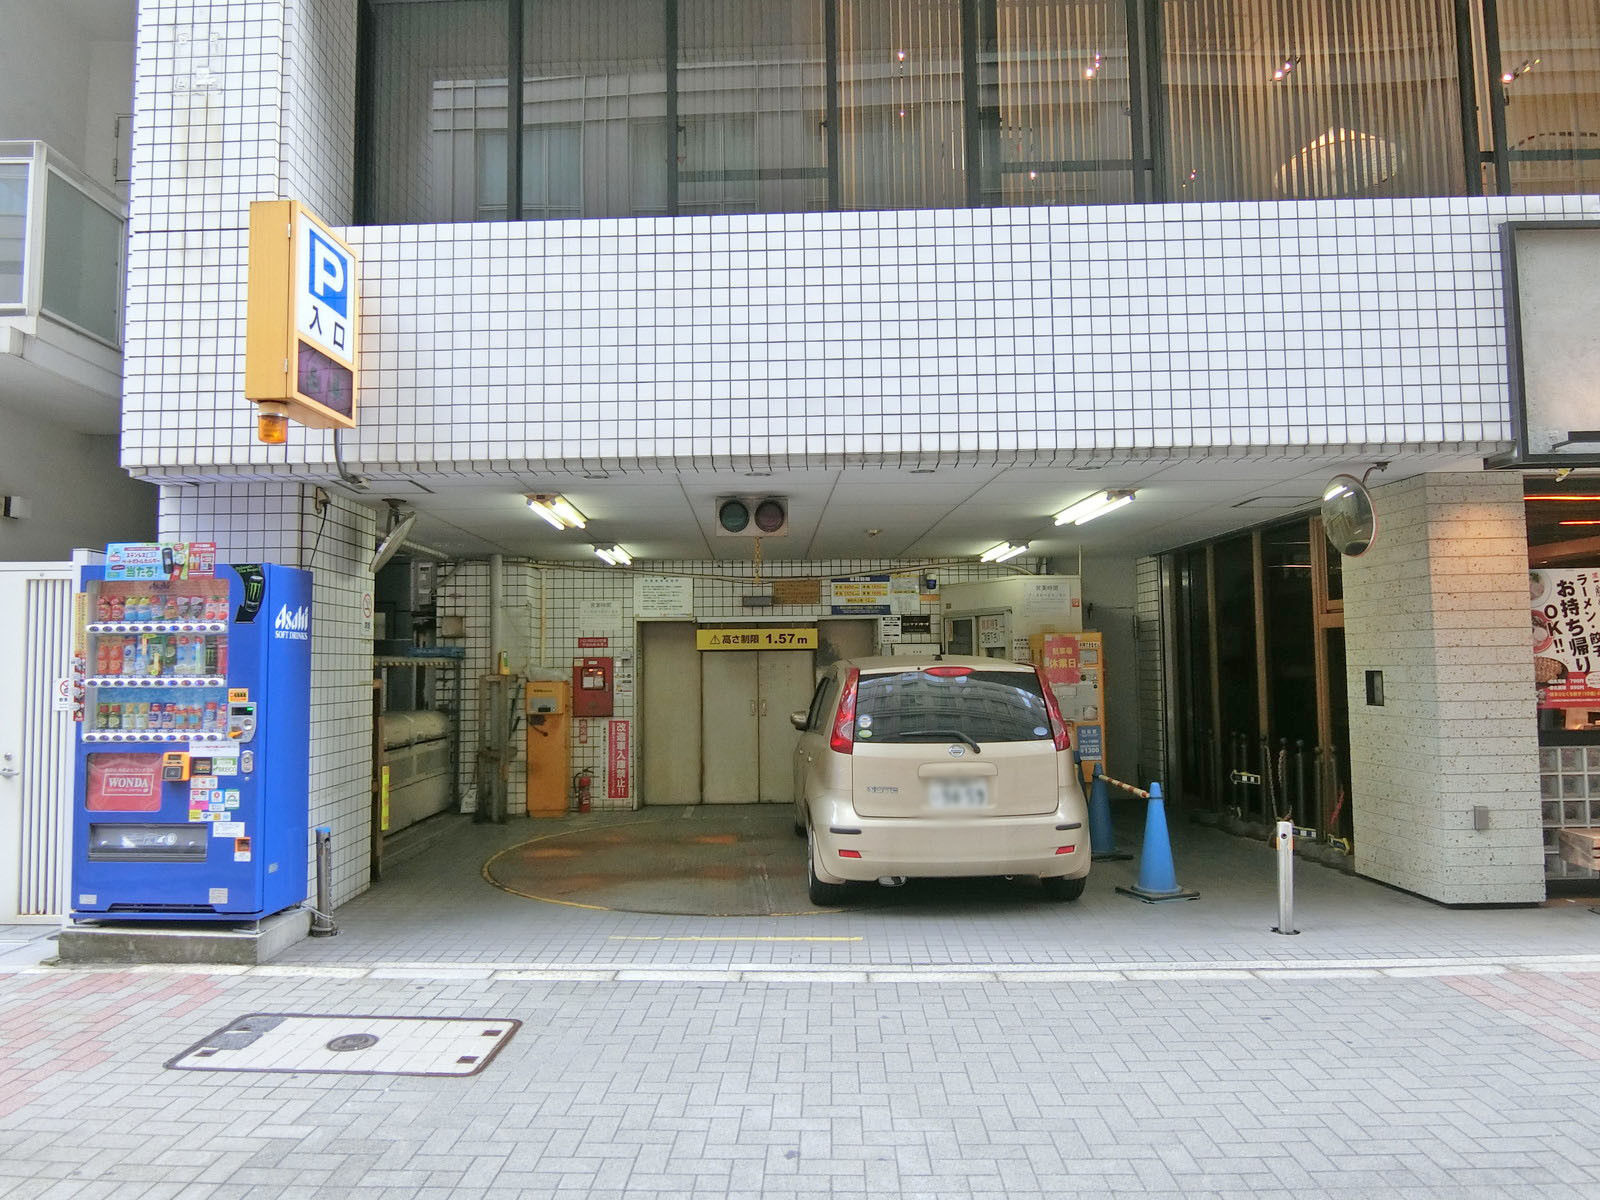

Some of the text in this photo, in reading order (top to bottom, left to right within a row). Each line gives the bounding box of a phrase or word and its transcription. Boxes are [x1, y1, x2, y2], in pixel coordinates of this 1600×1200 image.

[313, 236, 345, 297] P
[308, 304, 346, 351] 入口
[275, 603, 309, 631] Asahi
[1556, 579, 1592, 675] お持ち帰り
[275, 630, 289, 639] SOFT
[722, 634, 760, 644] 高さ制限
[1049, 657, 1077, 669] 休業日
[108, 777, 149, 788] WONDA
